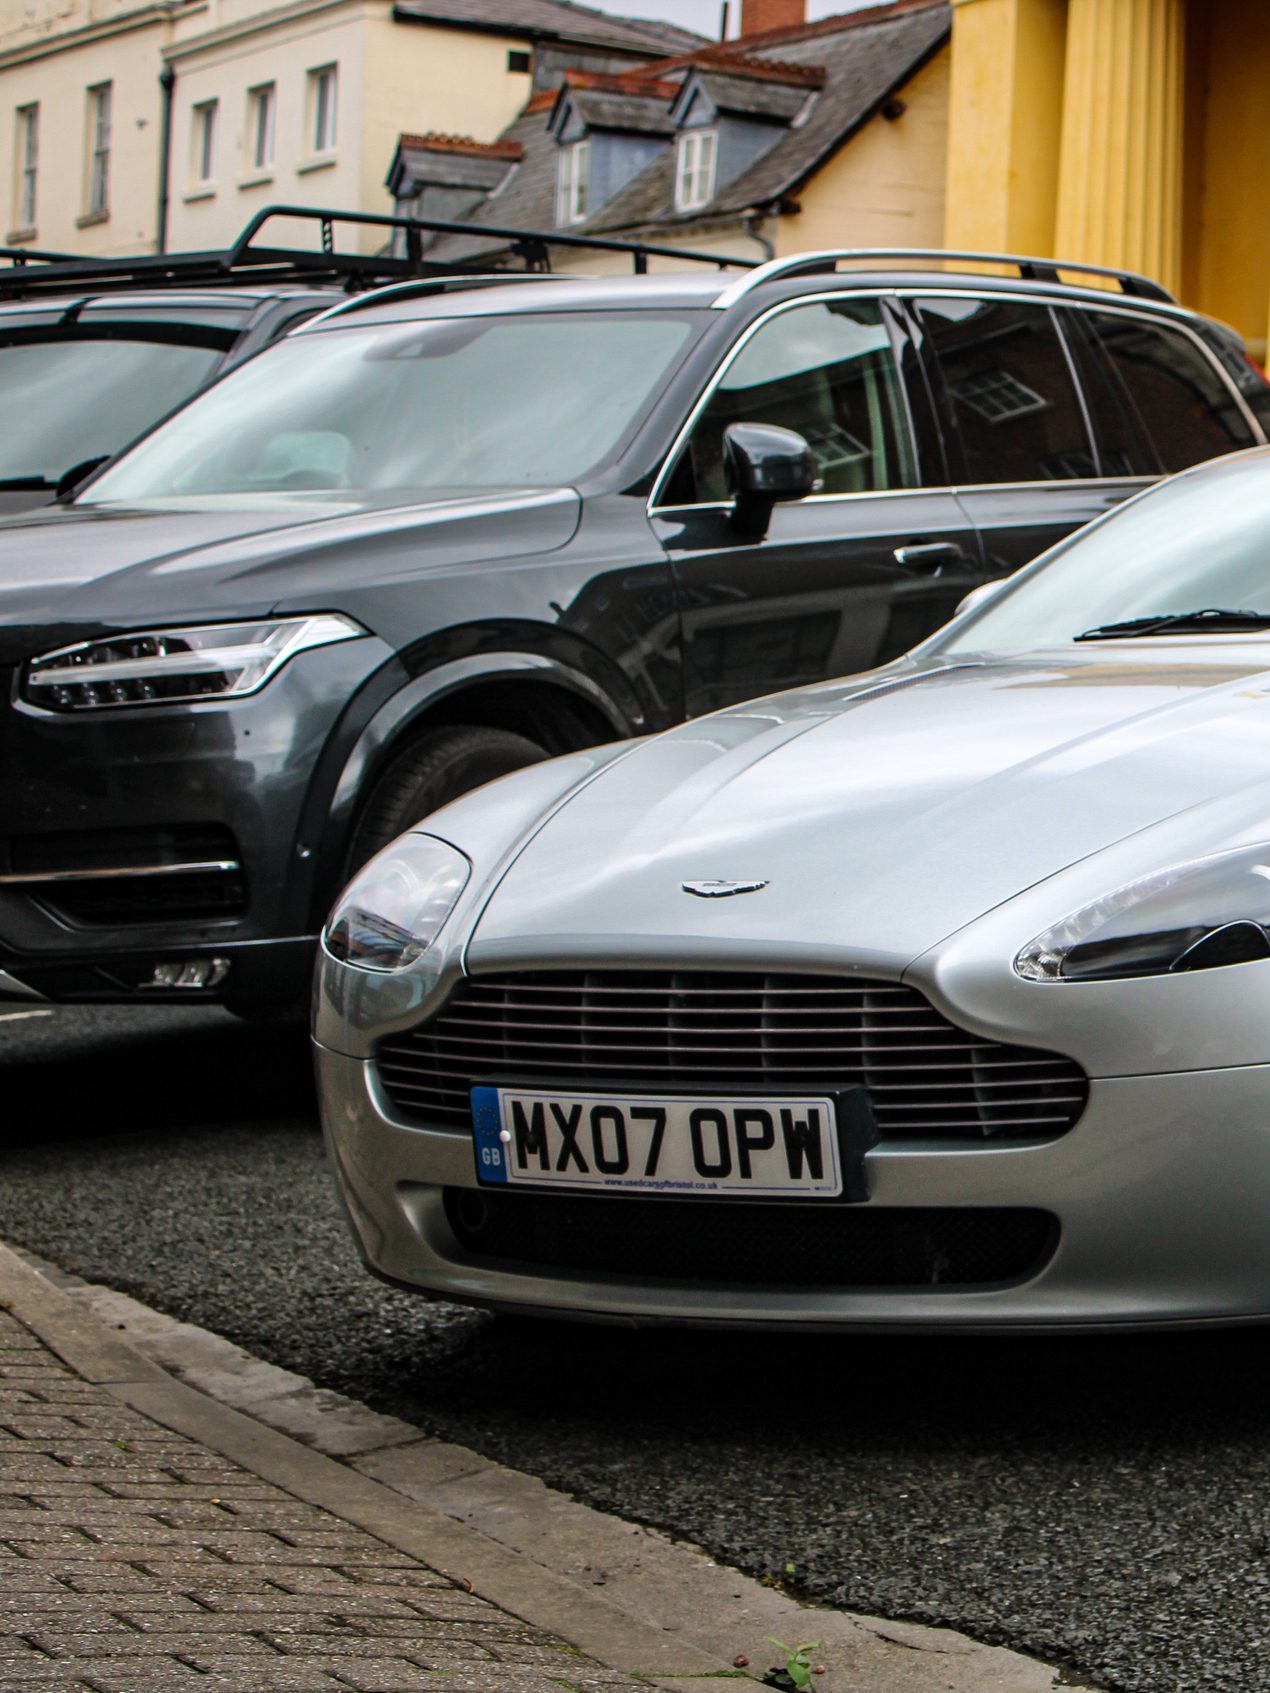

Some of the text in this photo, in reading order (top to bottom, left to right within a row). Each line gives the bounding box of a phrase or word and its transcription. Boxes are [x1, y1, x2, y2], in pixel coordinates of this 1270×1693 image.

[481, 1147, 501, 1166] GB
[511, 1100, 824, 1180] MX07 OPW
